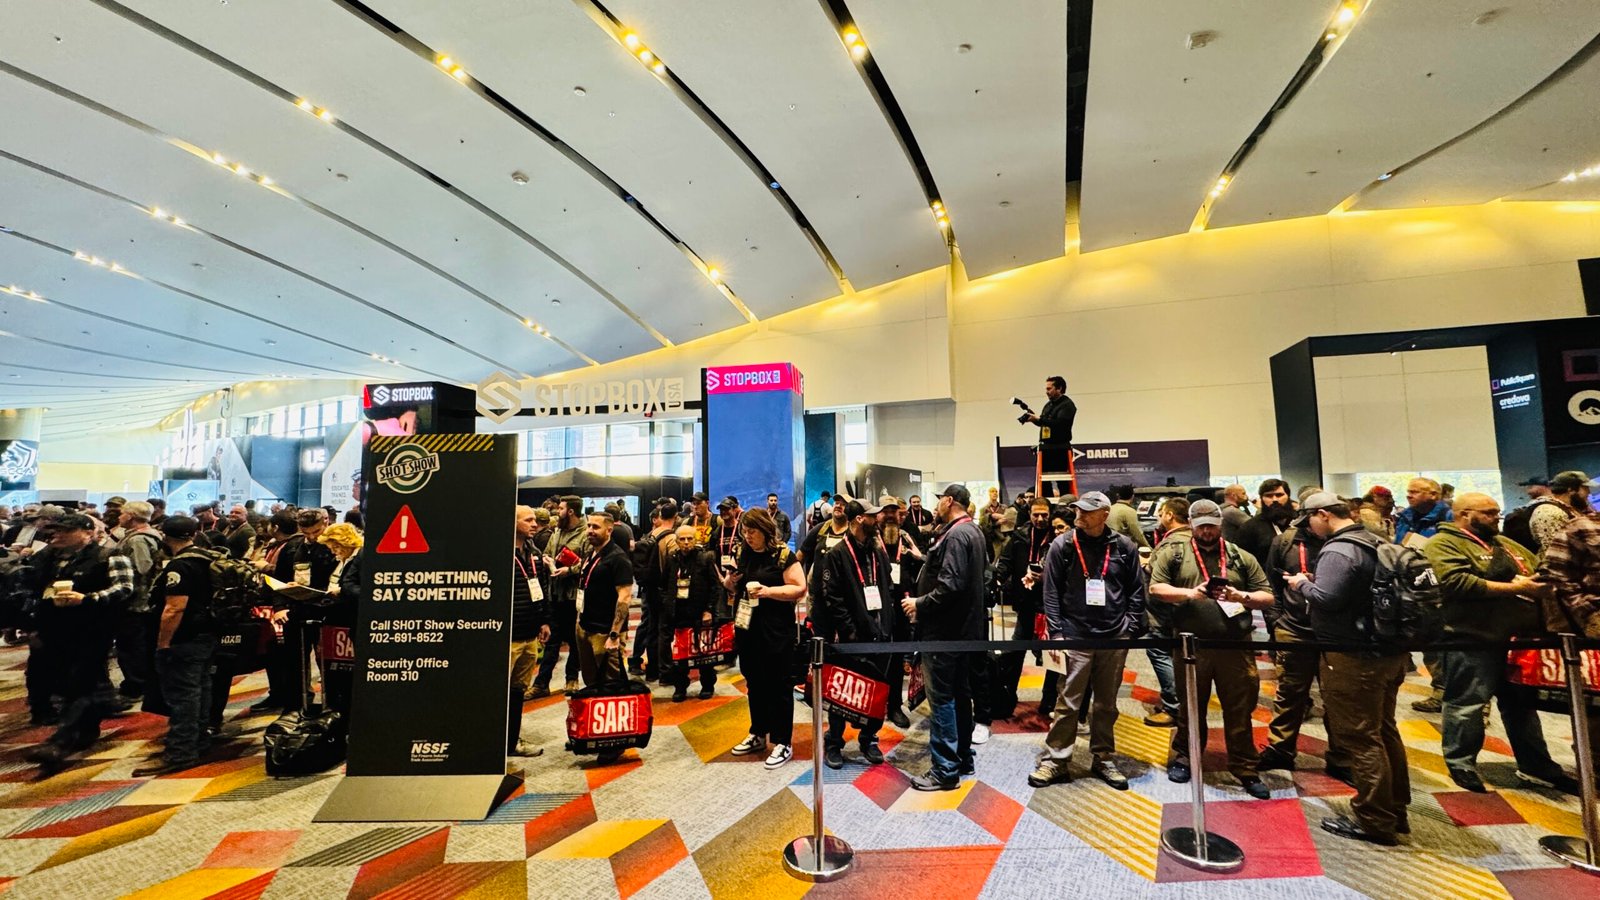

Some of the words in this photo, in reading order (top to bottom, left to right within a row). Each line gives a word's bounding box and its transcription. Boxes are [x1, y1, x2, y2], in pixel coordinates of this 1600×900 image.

[724, 371, 772, 386] STOPBOX
[392, 386, 434, 402] STOPBOX
[534, 377, 665, 417] STOPBOX
[1499, 394, 1530, 406] credova
[1086, 448, 1118, 459] DARK
[379, 462, 407, 480] SHOT
[408, 456, 437, 471] SHOW
[374, 572, 402, 585] SEE
[404, 571, 492, 585] SOMETHING,
[372, 588, 405, 601] SAY
[407, 587, 491, 600] SOMETHING
[370, 620, 391, 631] Call
[392, 620, 423, 630] SHOT
[424, 619, 455, 630] Show
[456, 619, 503, 631] Security
[335, 630, 355, 657] SA
[369, 633, 444, 643] 702-691-8522
[367, 658, 413, 670] Security
[415, 657, 449, 668] Office
[366, 671, 398, 681] Room
[400, 671, 419, 681] 310
[830, 671, 866, 709] SAR
[592, 701, 629, 734] SAR
[411, 743, 450, 754] NSSF
